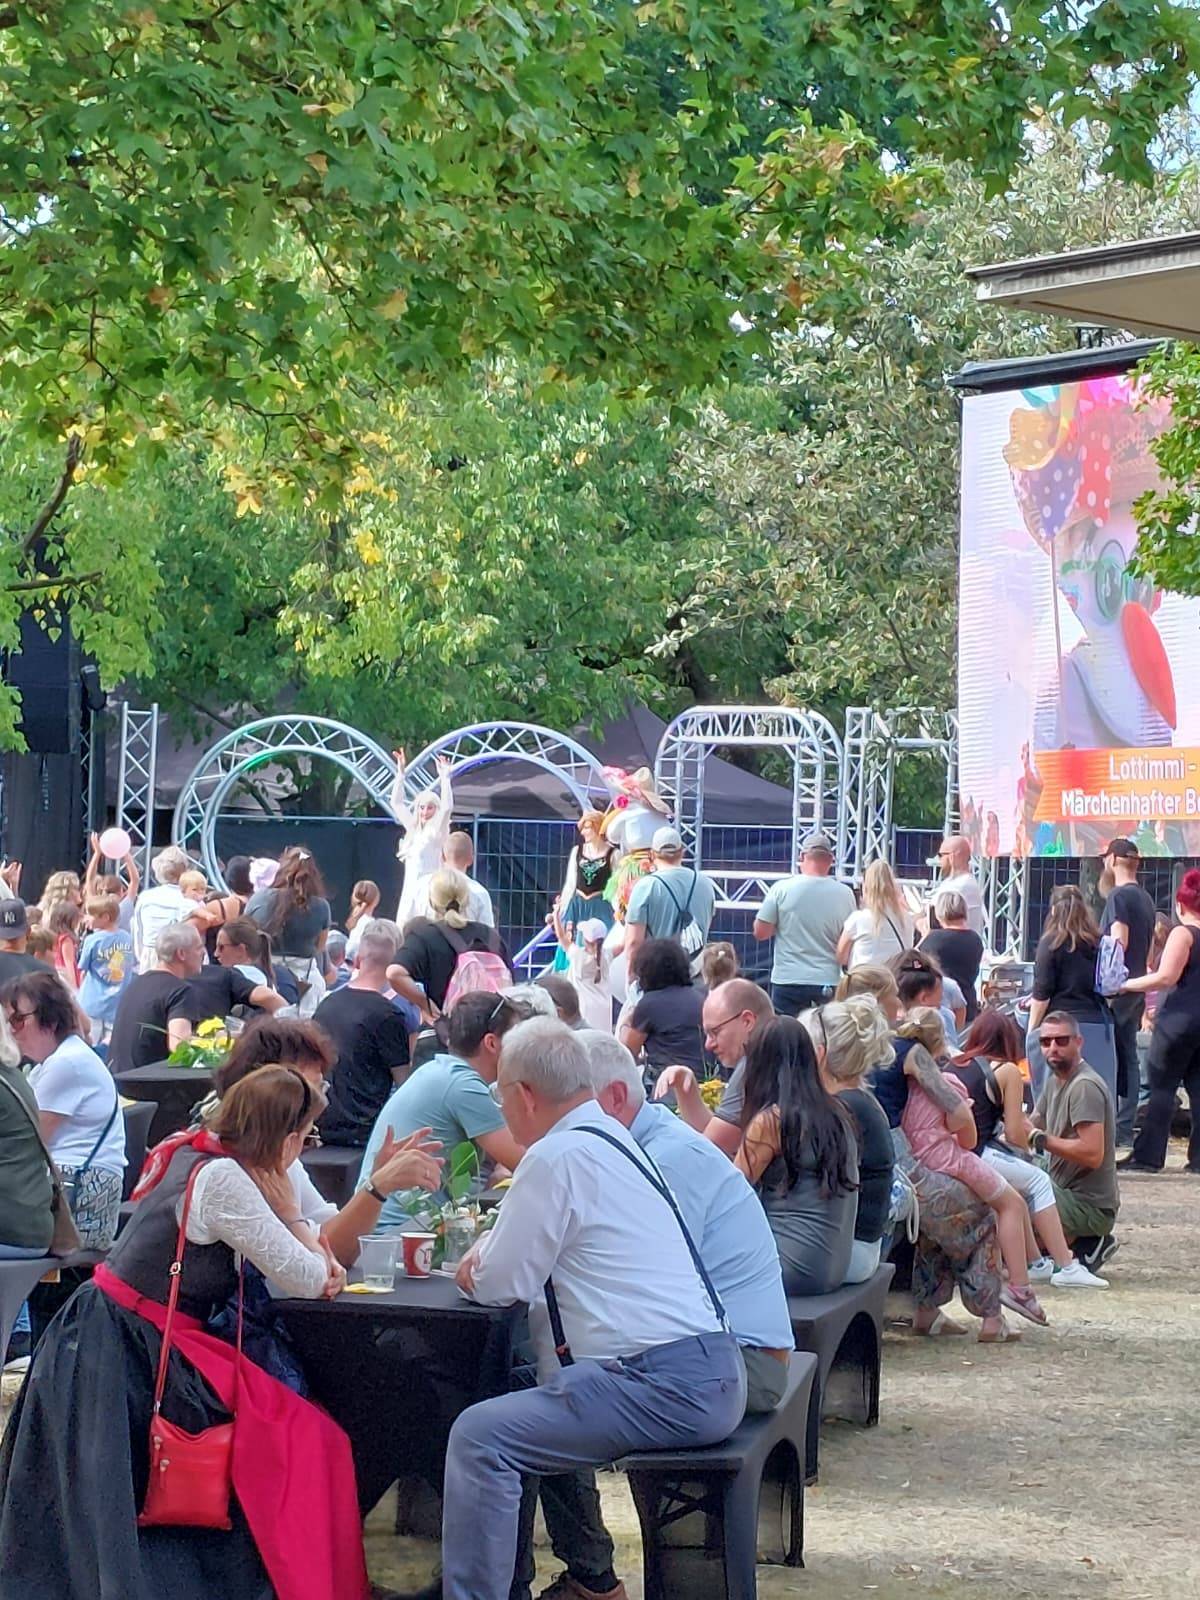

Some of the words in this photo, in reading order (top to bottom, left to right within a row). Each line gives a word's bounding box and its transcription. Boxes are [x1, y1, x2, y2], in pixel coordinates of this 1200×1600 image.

[1108, 752, 1185, 780] Lottimmi
[1060, 787, 1181, 817] Märchenhafter
[1184, 787, 1200, 815] B
